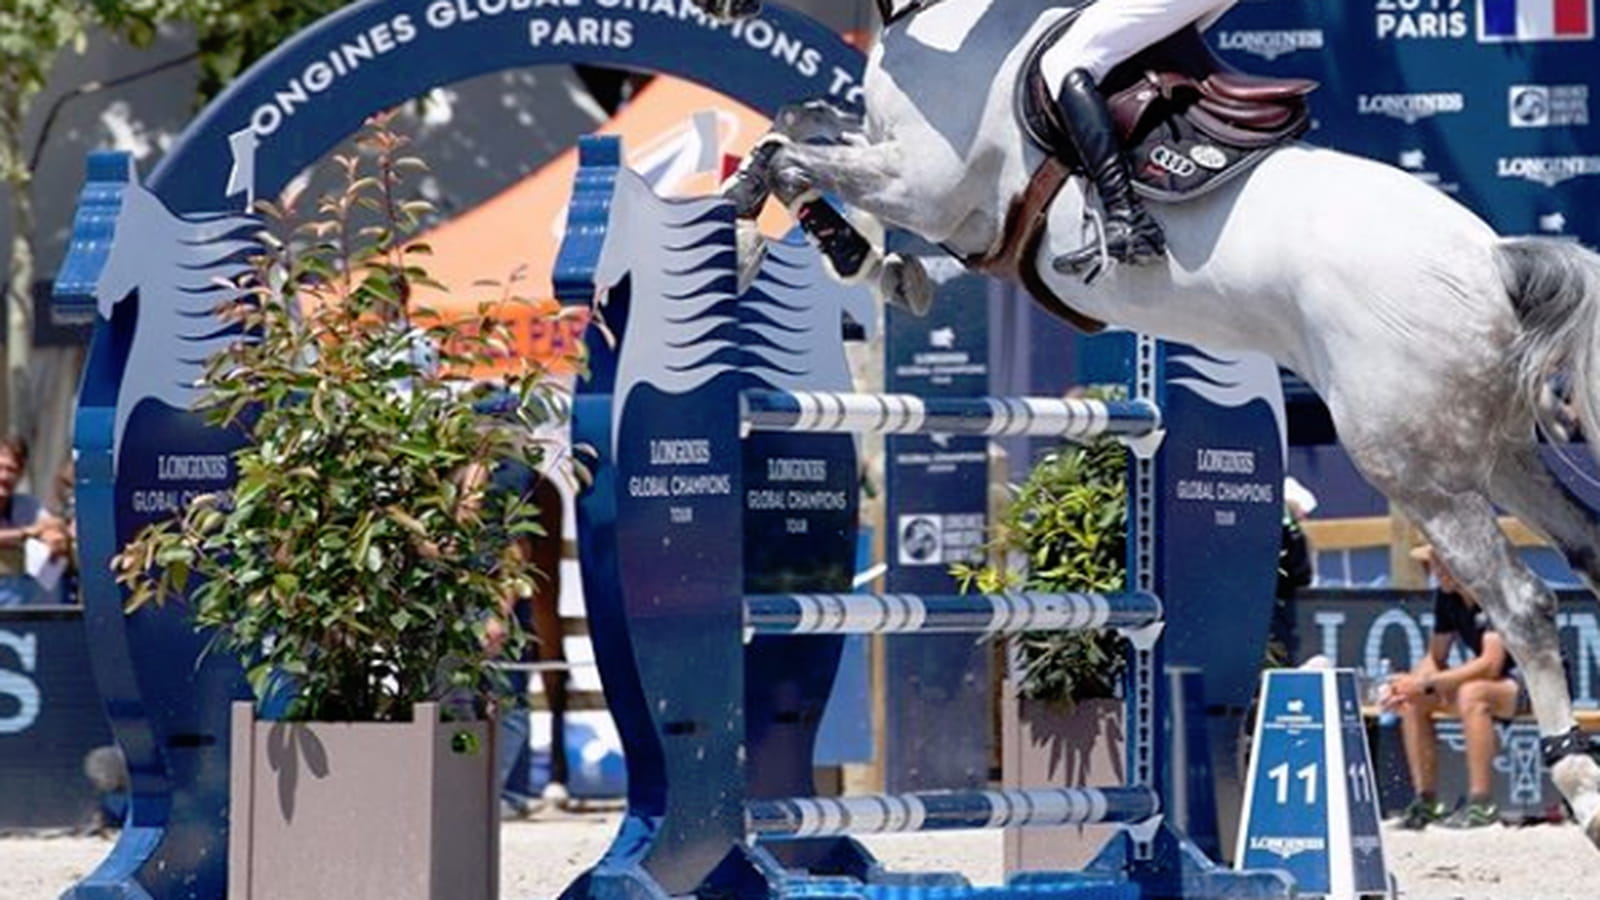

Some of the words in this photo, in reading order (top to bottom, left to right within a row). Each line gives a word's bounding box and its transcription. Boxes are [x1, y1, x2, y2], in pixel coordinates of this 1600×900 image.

[529, 18, 634, 47] PARIS
[1376, 11, 1468, 39] PARIS
[1218, 30, 1324, 49] LONGINES
[250, 13, 417, 137] ONGINES
[1357, 94, 1464, 113] LONGINES
[157, 454, 228, 480] LONGINES
[629, 476, 670, 497] GLOBAL
[671, 474, 731, 496] CHAMPIONS
[1176, 480, 1215, 499] GLOBAL
[1217, 481, 1274, 503] CHAMPIONS
[132, 489, 178, 513] GLOBAL
[747, 491, 787, 511] GLOBAL
[788, 490, 847, 511] CHAMPIONS
[1267, 761, 1319, 805] 11
[1349, 762, 1371, 803] 11
